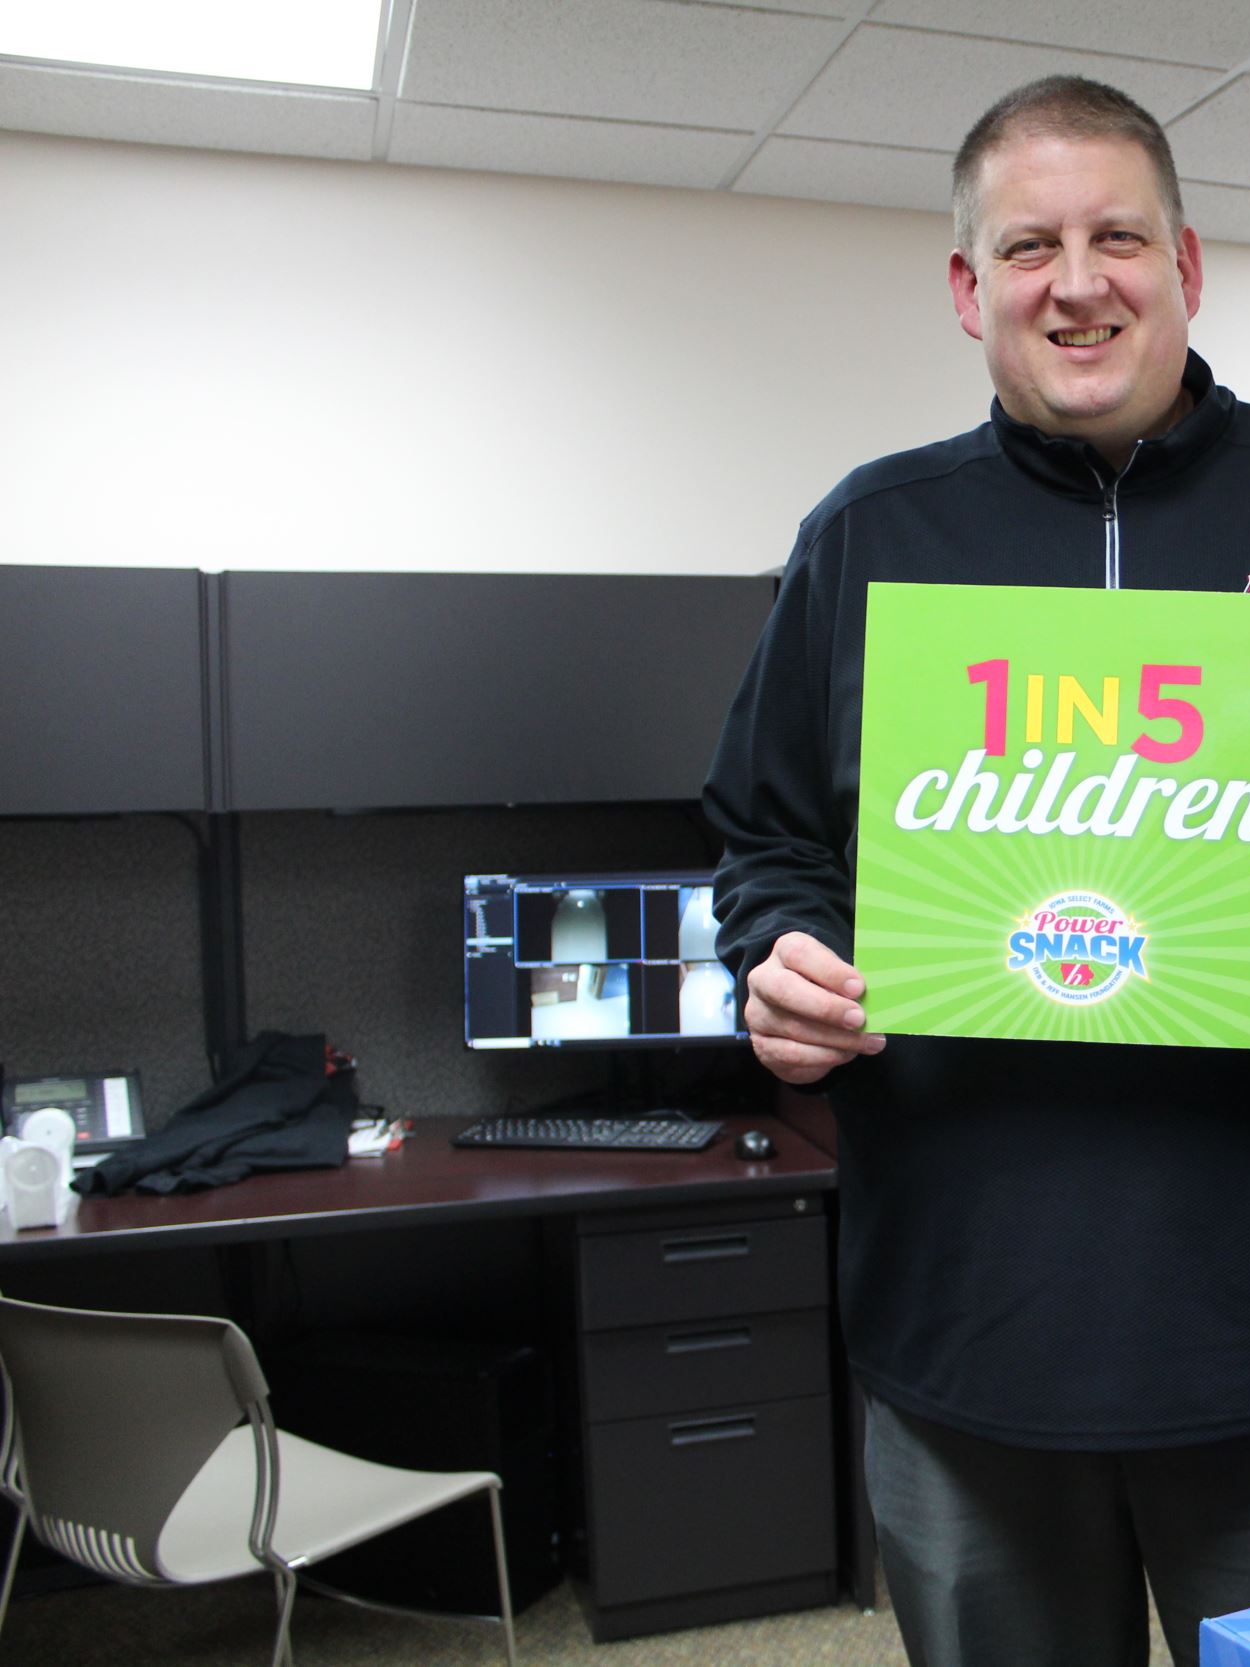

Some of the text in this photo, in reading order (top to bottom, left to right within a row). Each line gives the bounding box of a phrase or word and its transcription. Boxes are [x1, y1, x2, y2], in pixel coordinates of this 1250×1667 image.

[1048, 898, 1066, 909] IOWA
[1093, 896, 1115, 914] FARMS
[1034, 911, 1124, 934] Power
[1008, 932, 1146, 977] SNACK
[1061, 992, 1088, 1000] HANSEN
[1090, 970, 1123, 999] FOUNDATION
